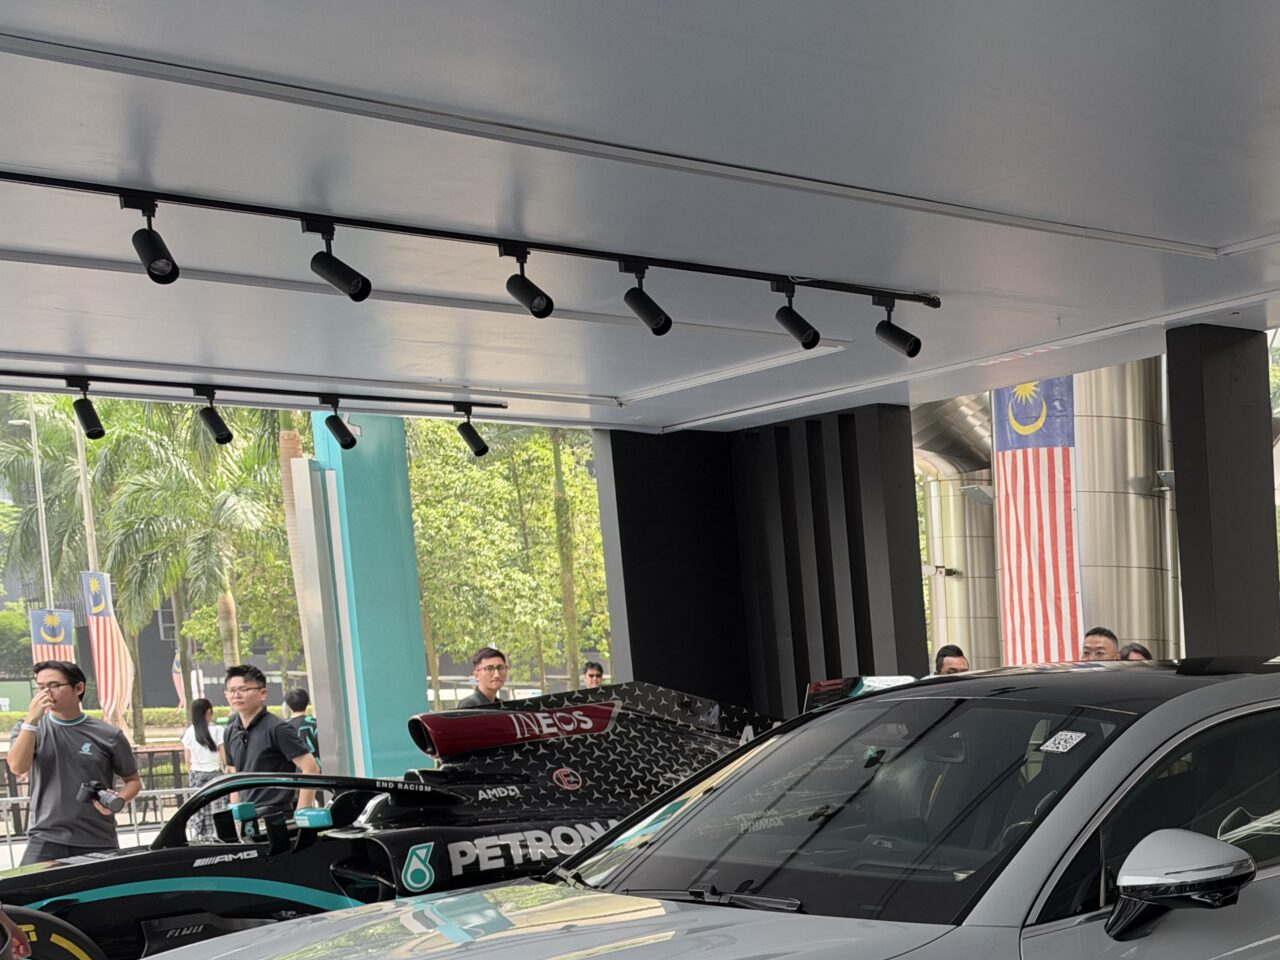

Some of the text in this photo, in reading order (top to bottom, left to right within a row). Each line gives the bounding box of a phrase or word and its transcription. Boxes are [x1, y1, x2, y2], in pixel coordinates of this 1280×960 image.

[509, 710, 593, 739] INEOS
[376, 780, 432, 792] END RACISM
[477, 787, 509, 800] AMD
[447, 818, 622, 877] PETRON
